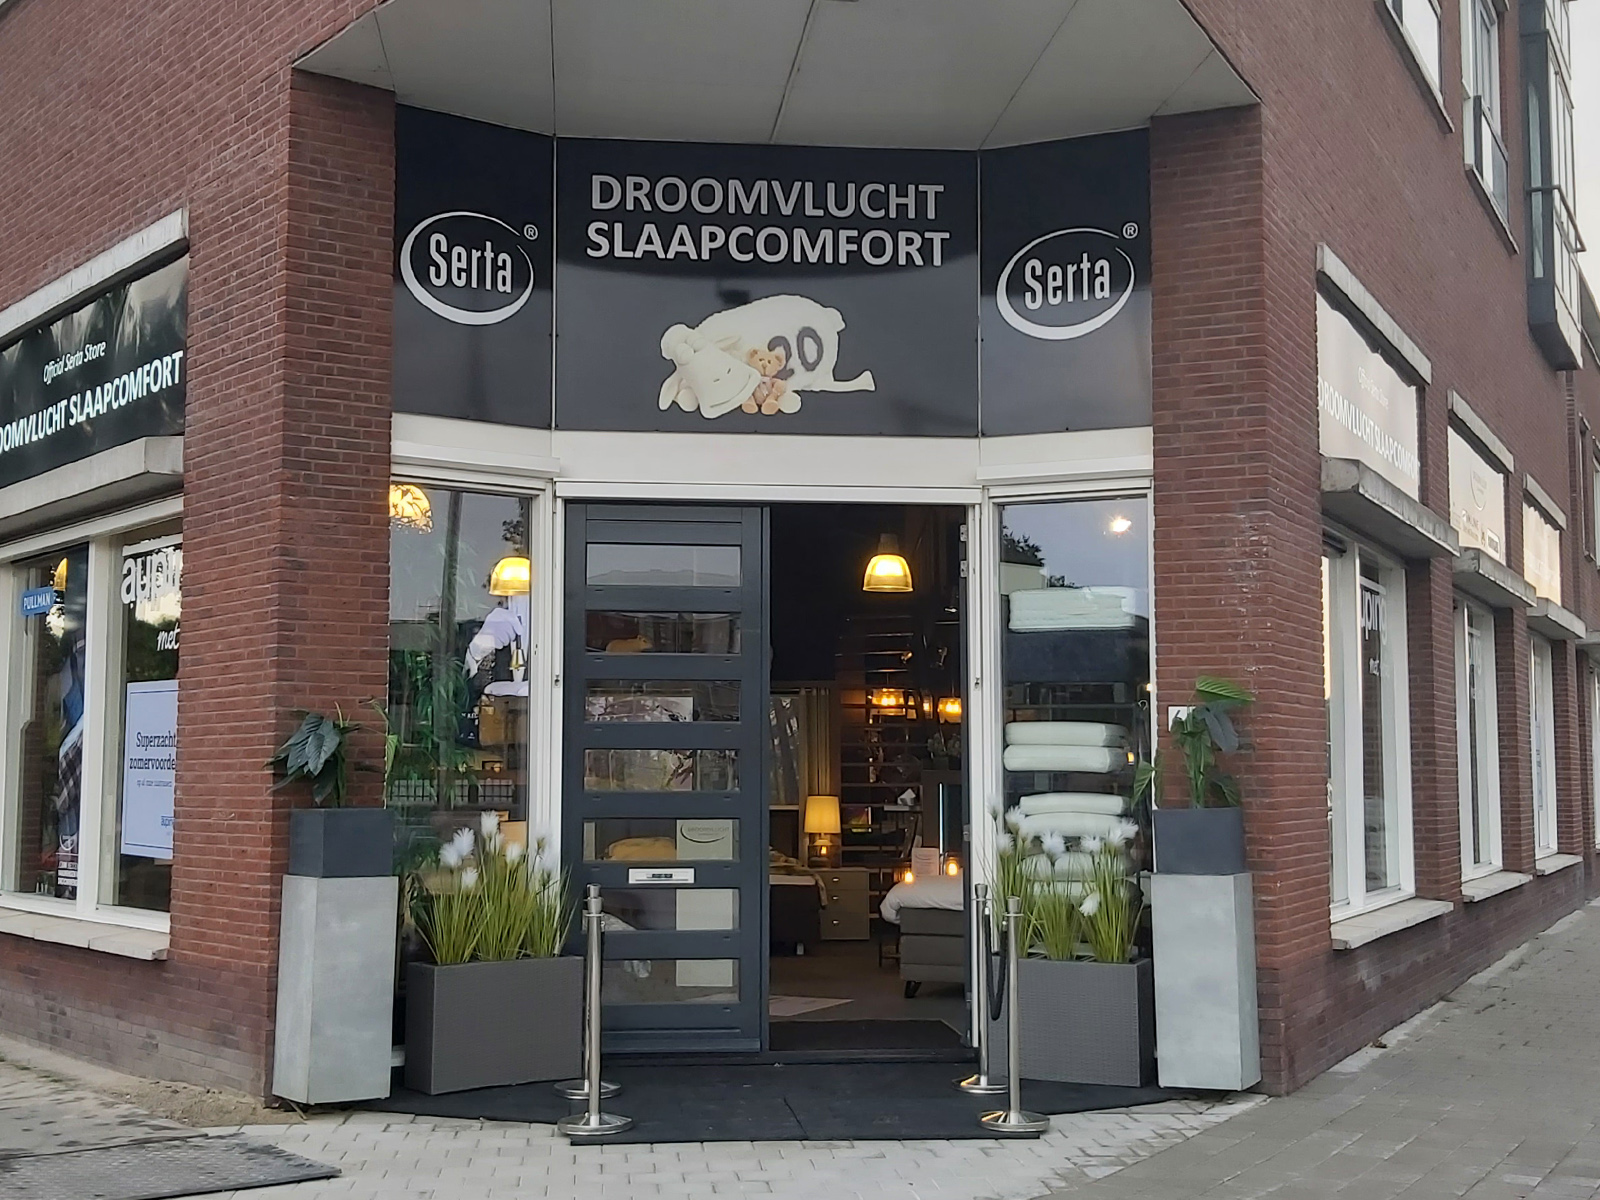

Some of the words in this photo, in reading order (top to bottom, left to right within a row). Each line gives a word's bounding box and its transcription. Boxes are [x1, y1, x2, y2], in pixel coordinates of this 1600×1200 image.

[591, 173, 945, 220] DROOMVLUCHT
[429, 233, 512, 293] Serta
[586, 221, 950, 267] SLAAPCOMFORT
[1024, 252, 1110, 310] Serta
[64, 350, 84, 372] Serta
[84, 341, 107, 362] Store
[69, 350, 184, 426] SLAAPCOMFORT
[23, 592, 51, 610] PULLMAN
[156, 622, 180, 652] met
